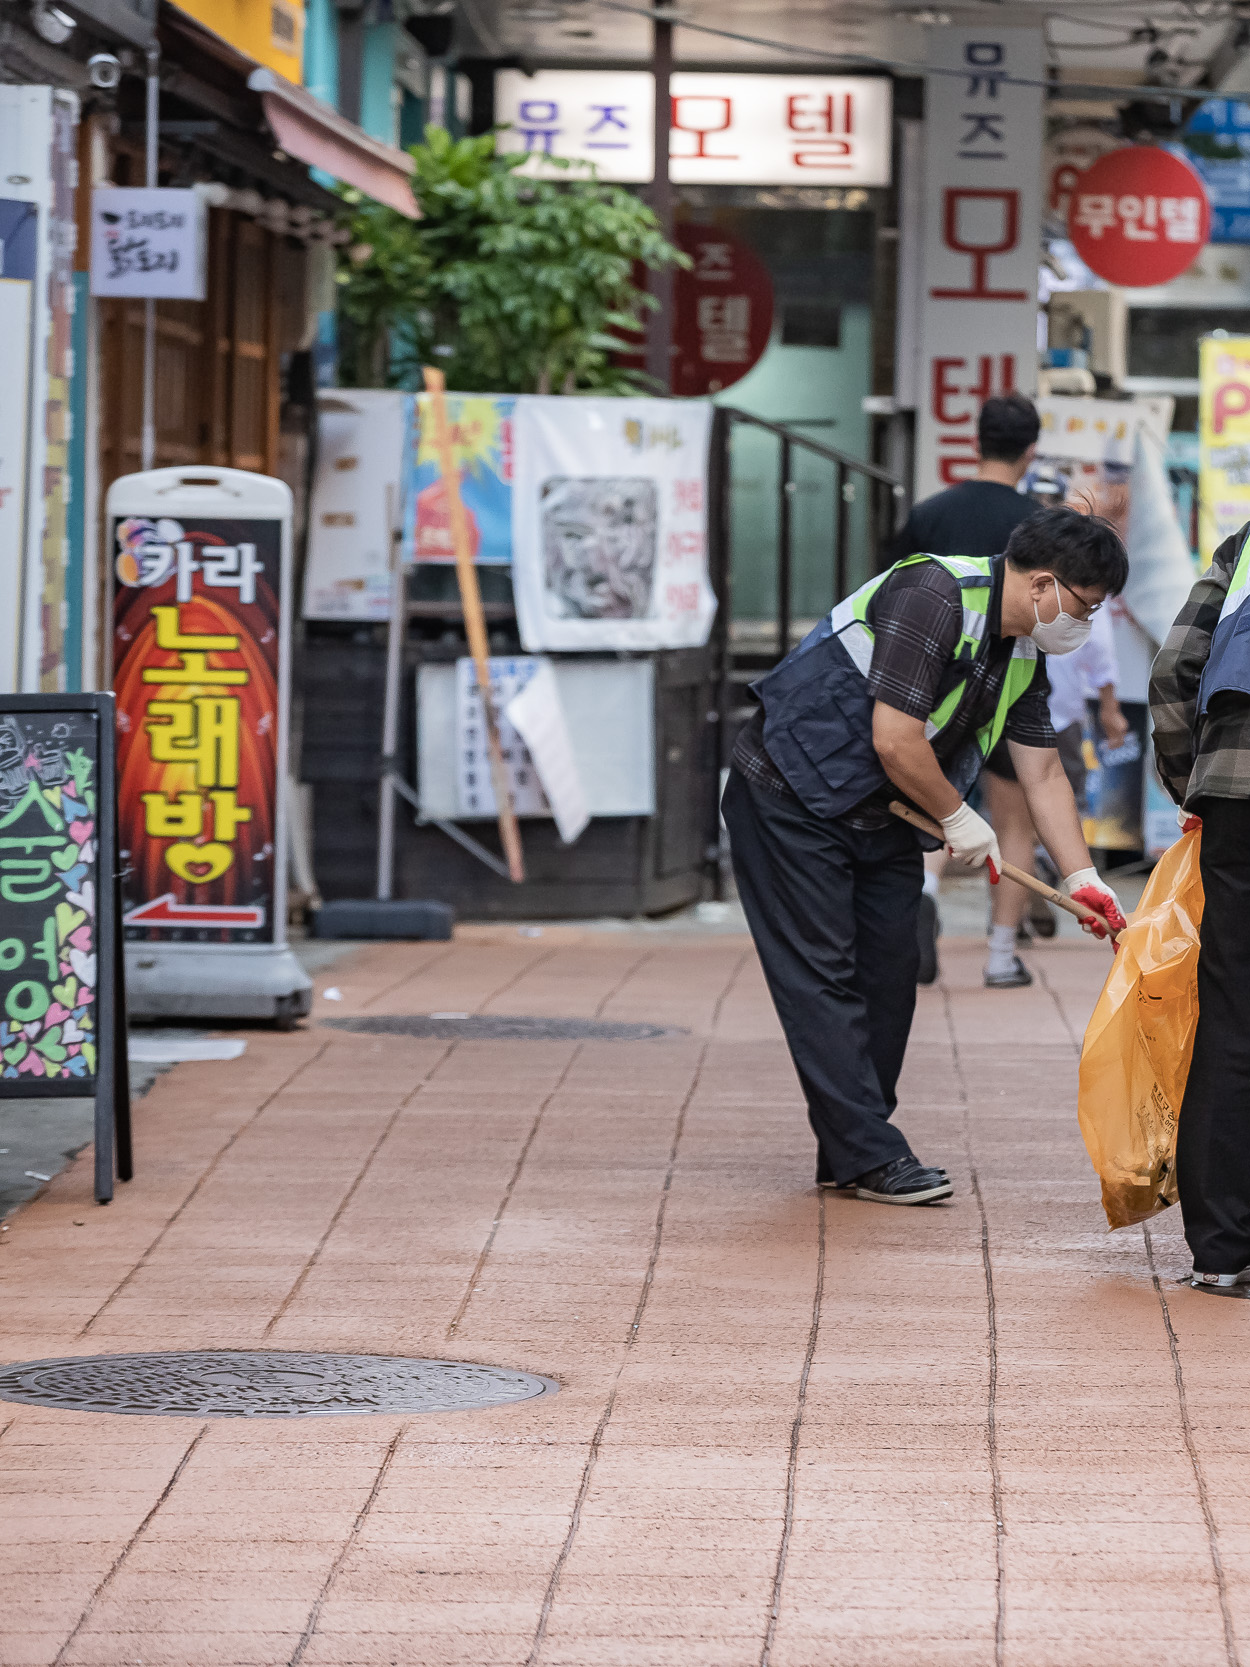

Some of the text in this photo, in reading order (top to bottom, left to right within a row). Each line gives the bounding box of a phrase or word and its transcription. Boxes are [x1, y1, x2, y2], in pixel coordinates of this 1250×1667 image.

[671, 92, 856, 170] 모텔
[957, 41, 1008, 160] 뮤즈
[1075, 195, 1200, 243] 무인텔
[140, 543, 264, 604] 카라
[141, 605, 253, 884] 노래방
